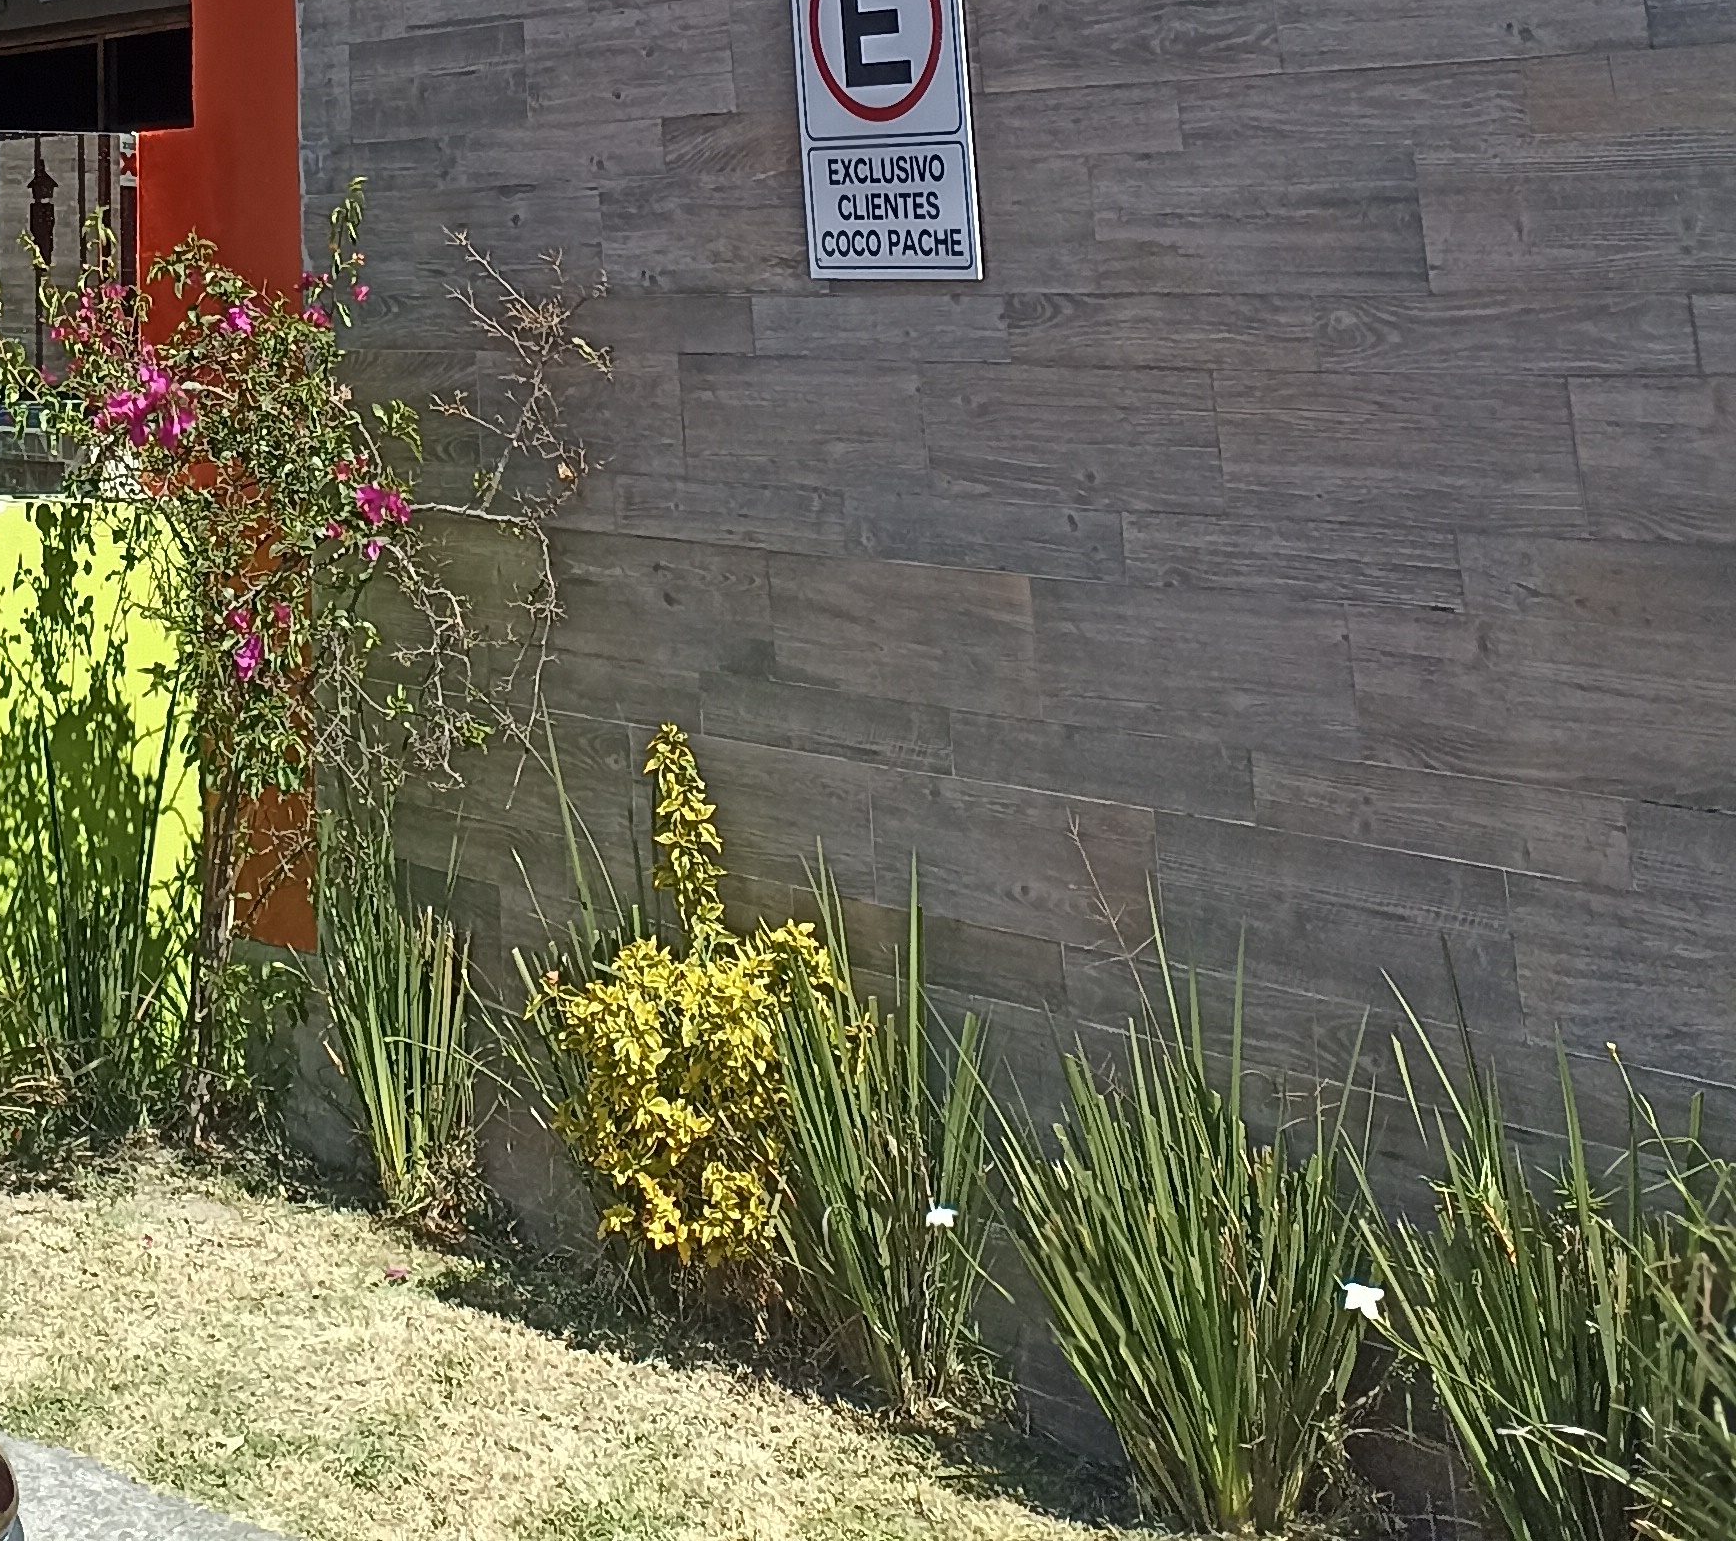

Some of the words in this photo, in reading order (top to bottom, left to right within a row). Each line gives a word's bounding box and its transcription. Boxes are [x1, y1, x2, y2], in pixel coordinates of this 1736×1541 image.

[826, 153, 946, 186] EXCLUSIVO
[837, 190, 941, 222] CLIENTES
[821, 230, 882, 258] COCO
[888, 228, 965, 257] PACHE
